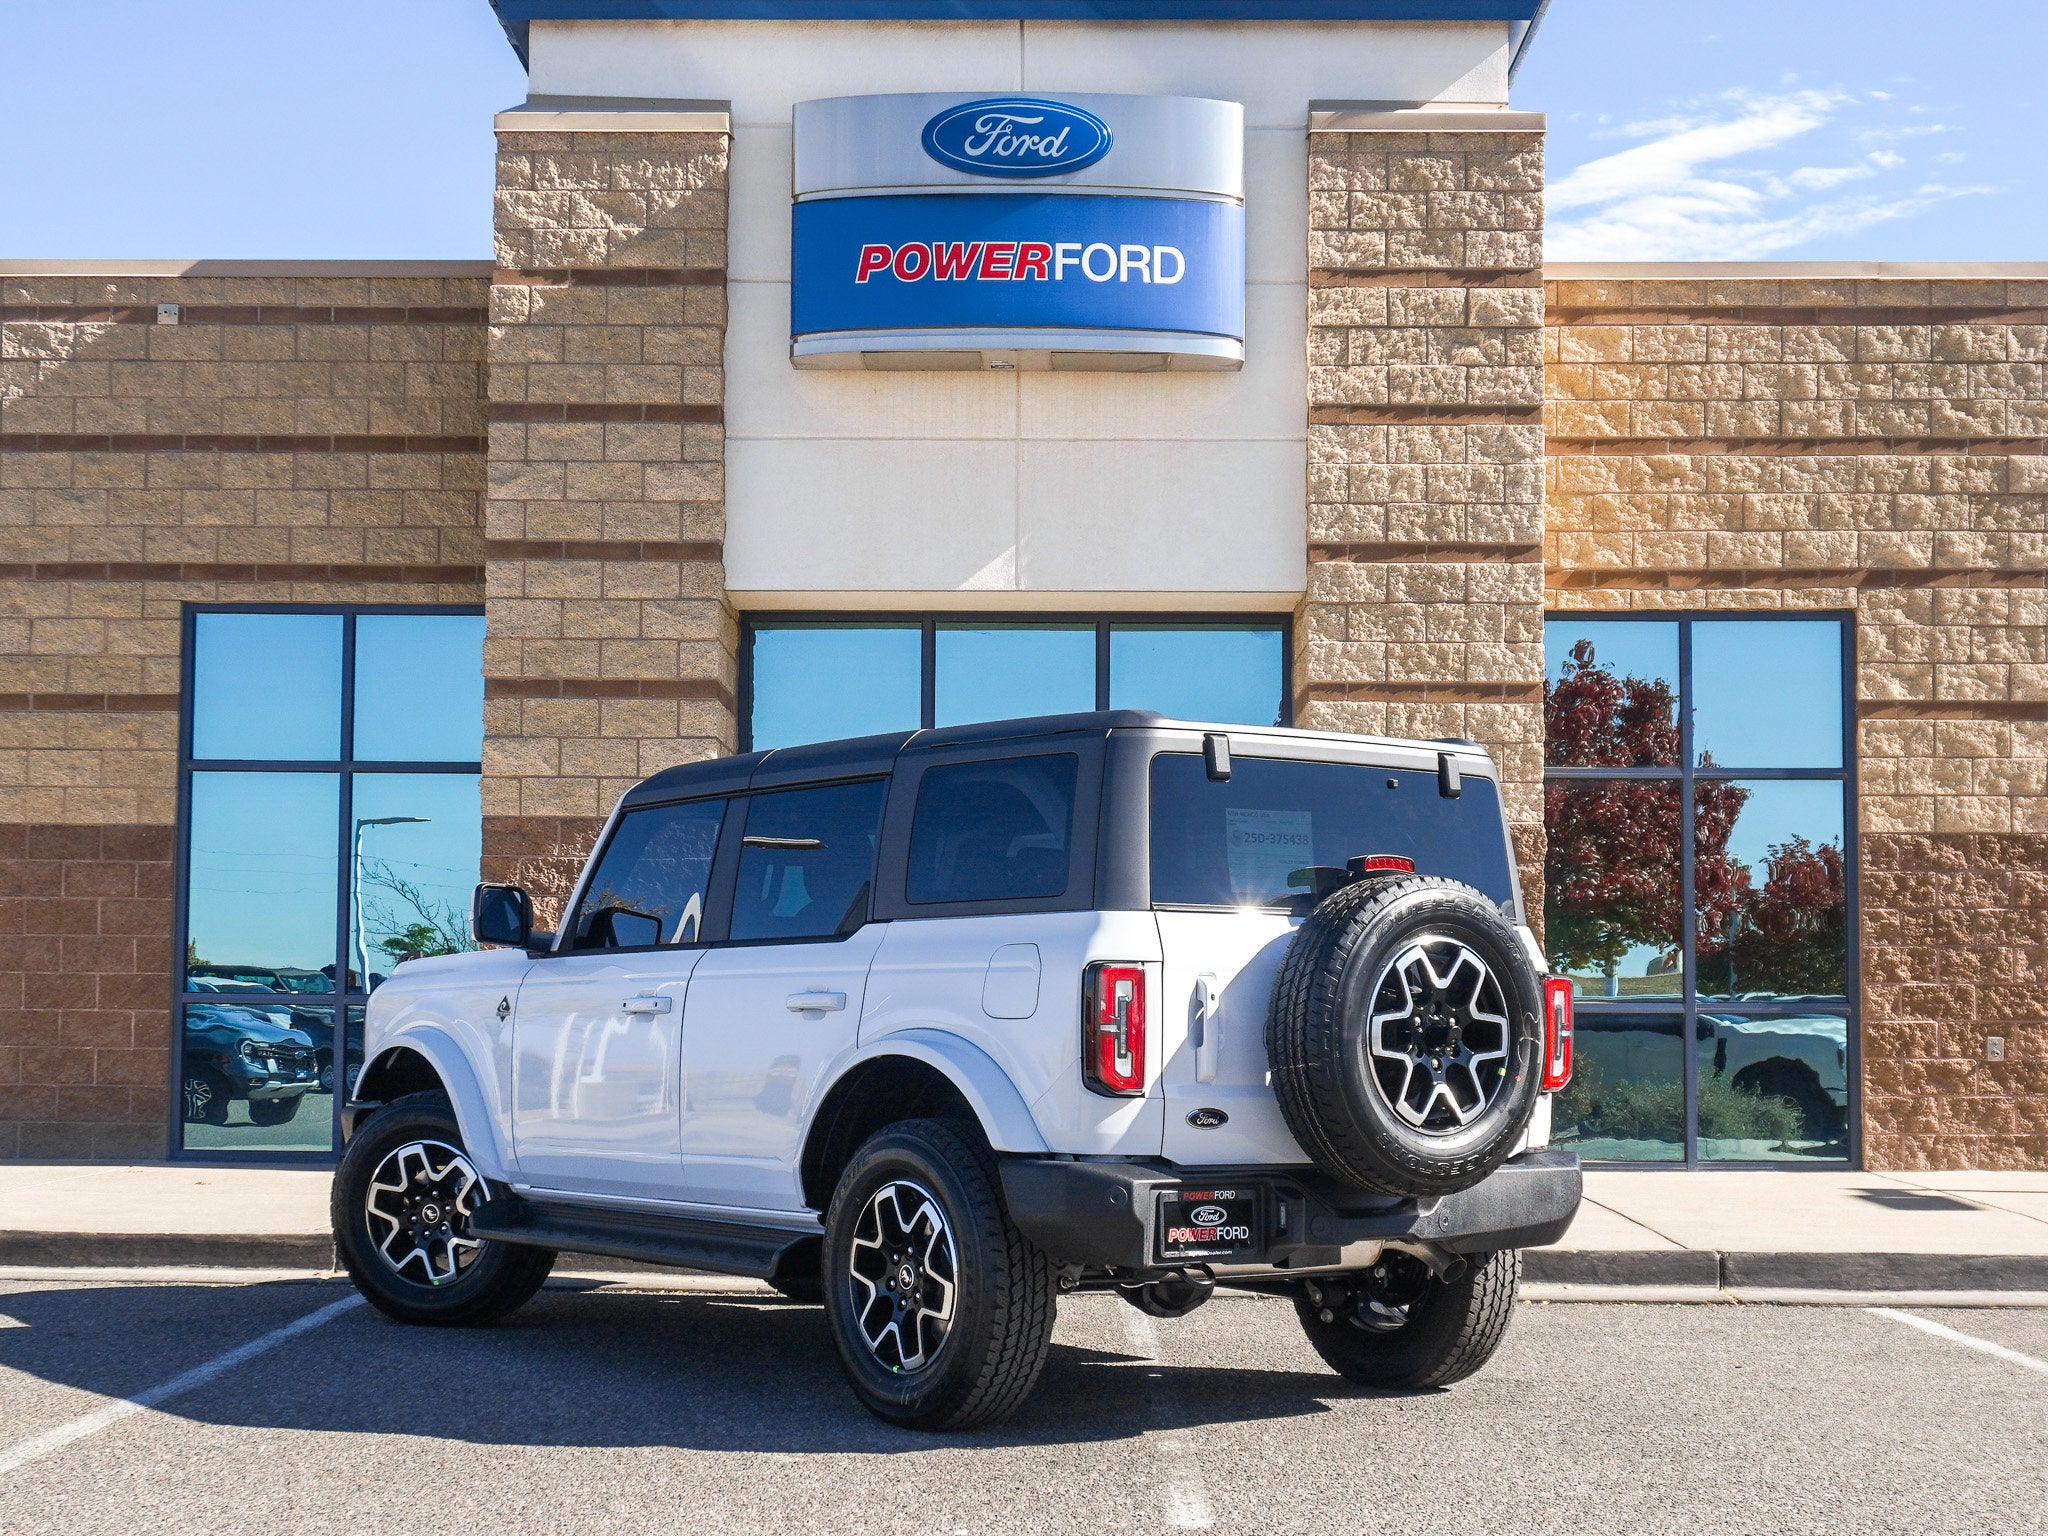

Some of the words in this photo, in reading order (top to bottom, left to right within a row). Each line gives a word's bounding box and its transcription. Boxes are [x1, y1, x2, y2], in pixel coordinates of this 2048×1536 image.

[964, 113, 1072, 158] Ford
[855, 241, 1186, 285] POWERFORD
[1196, 1112, 1220, 1125] Ford
[1183, 1190, 1236, 1201] POWERFORD
[1198, 1209, 1220, 1221] Ford
[1168, 1226, 1249, 1243] POWERFORD
